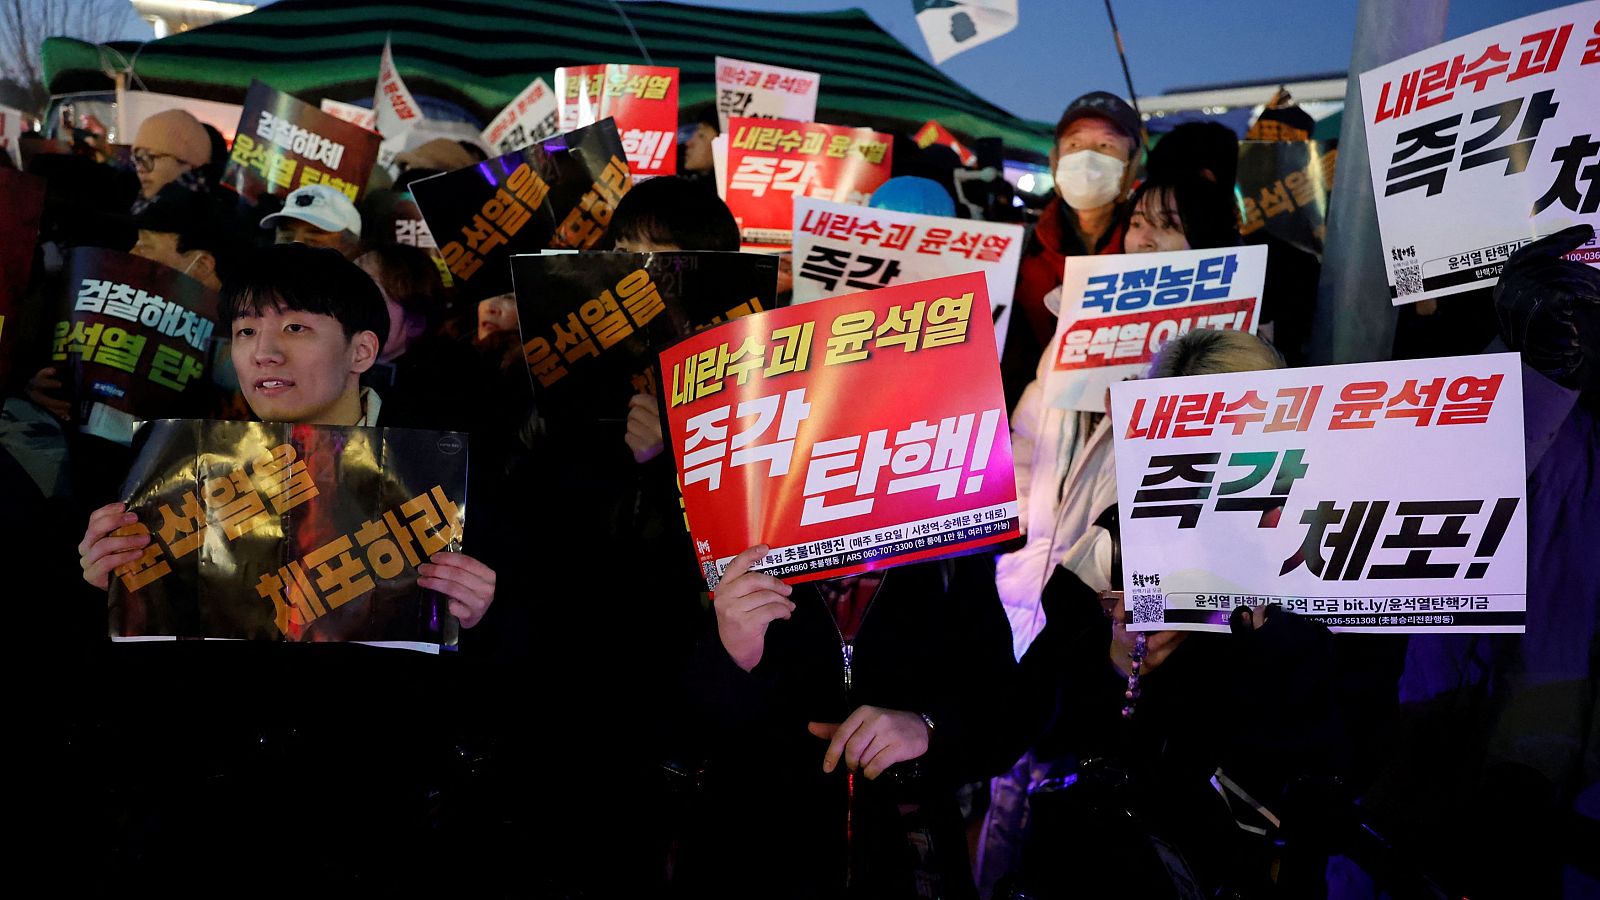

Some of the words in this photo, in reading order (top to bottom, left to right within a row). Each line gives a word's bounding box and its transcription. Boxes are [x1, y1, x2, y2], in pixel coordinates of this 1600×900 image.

[1374, 23, 1575, 125] 내란수괴
[230, 133, 298, 190] 윤석열
[620, 128, 676, 170] 핵!
[732, 126, 827, 155] 내란수괴
[1384, 88, 1560, 198] 즉각
[729, 155, 818, 198] 즉각
[442, 162, 551, 281] 윤석열을
[799, 209, 916, 252] 내란수괴
[916, 227, 1013, 263] 윤석열
[799, 245, 904, 292] 즉각
[1082, 253, 1239, 314] 국정농단
[1448, 254, 1484, 271] 윤석열
[524, 268, 667, 389] 윤석열을
[671, 321, 816, 409] 내란수괴
[823, 292, 975, 368] 윤석열
[1059, 321, 1151, 365] 윤석열
[1124, 384, 1325, 440] 내란수괴
[1328, 374, 1505, 431] 윤석열
[683, 387, 812, 492] 즉각
[799, 408, 1001, 527] 탄핵!
[1130, 449, 1310, 530] 즉각
[112, 442, 320, 594] 윤석열을
[255, 484, 465, 636] 체포하라
[784, 538, 846, 562] 촛불대행진
[849, 534, 873, 550] (매주
[874, 529, 904, 544] 토요일
[911, 515, 972, 537] 시청역-숭례문
[972, 512, 984, 523] 앞
[984, 507, 1008, 521] 대로)
[846, 549, 862, 563] ARS
[863, 540, 914, 558] 060-707-3300
[984, 522, 993, 533] 번
[1278, 497, 1521, 581] 체포!
[1132, 570, 1161, 588] 촛불행동
[1194, 594, 1231, 609] 윤석열
[1286, 599, 1308, 613] 5억
[1312, 599, 1340, 612] 모금
[1343, 596, 1490, 613] bit.ly/윤석열탄핵기금
